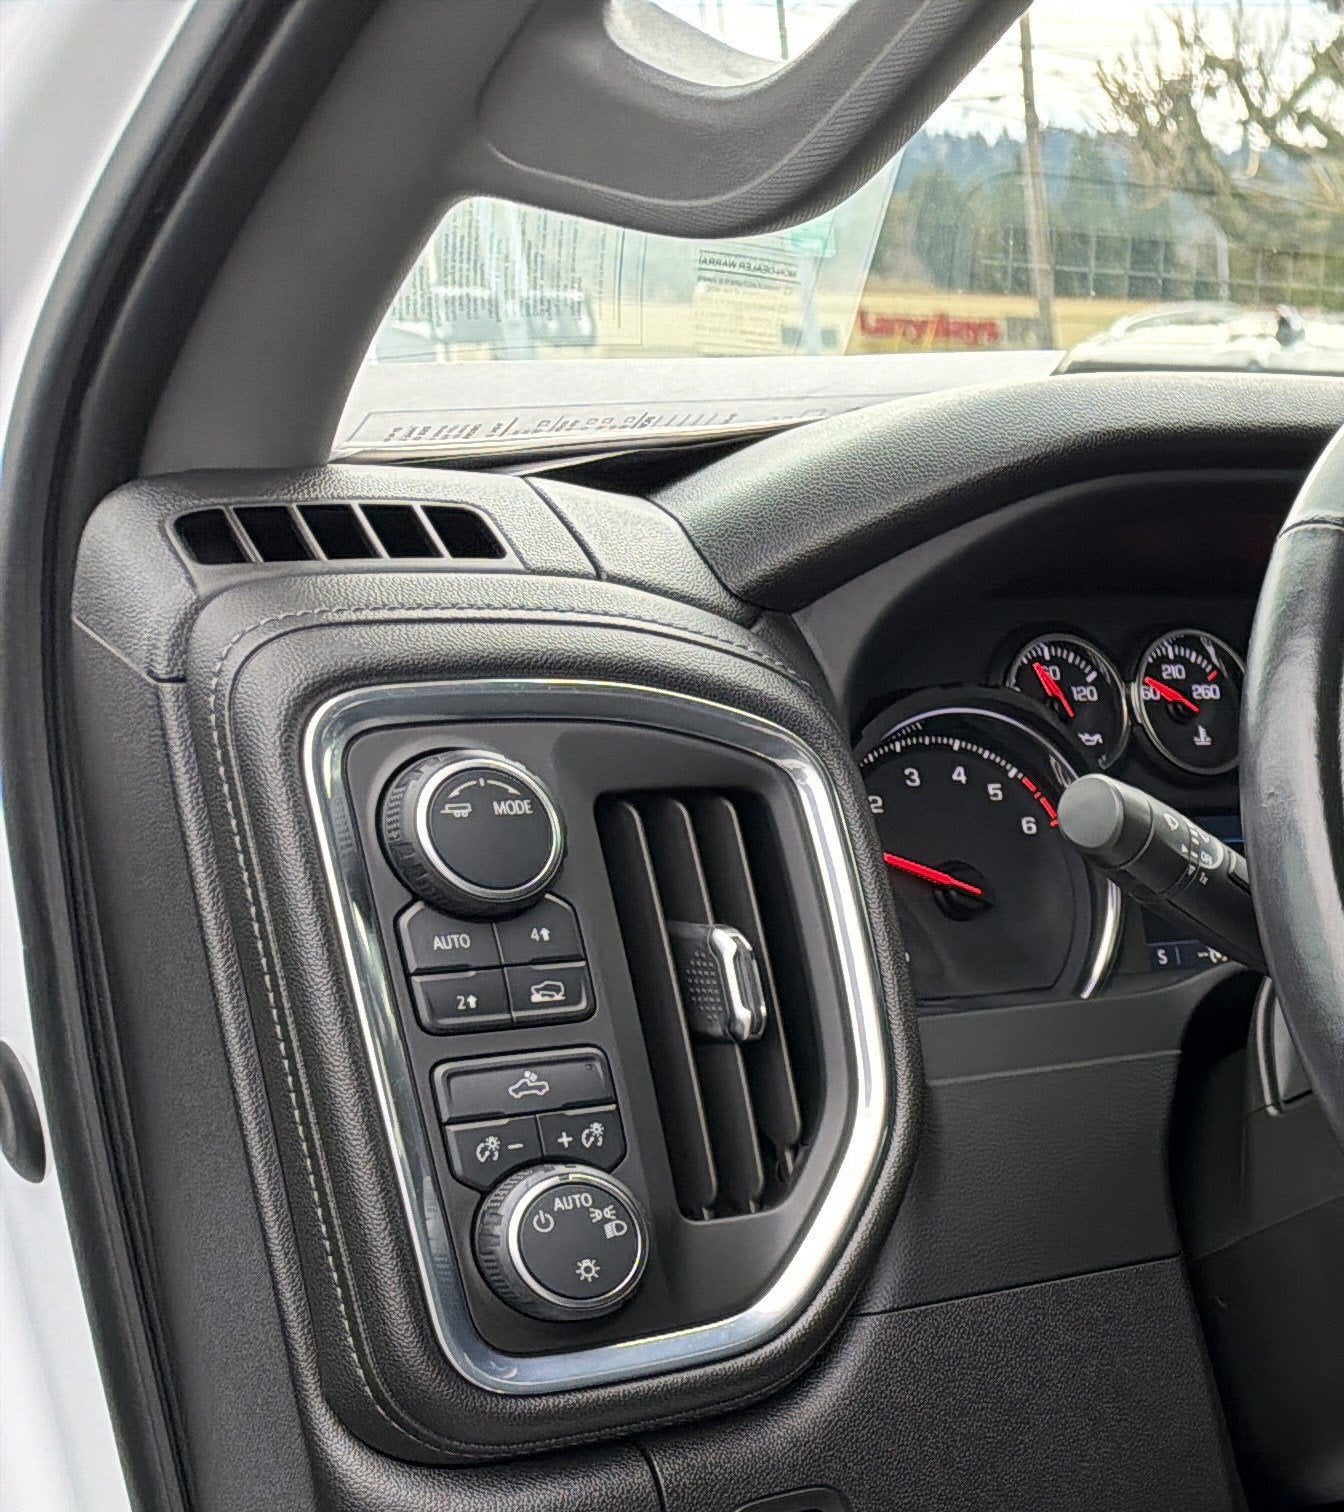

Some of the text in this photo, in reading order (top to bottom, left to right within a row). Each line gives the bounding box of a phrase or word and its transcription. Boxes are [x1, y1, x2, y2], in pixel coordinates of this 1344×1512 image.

[1161, 664, 1186, 680] 210
[1072, 685, 1099, 701] 120
[1191, 684, 1221, 700] 260
[903, 767, 921, 787] 3
[951, 766, 967, 785] 4
[986, 783, 1004, 801] 5
[492, 799, 534, 816] MODE
[868, 795, 884, 814] 2
[1021, 816, 1038, 835] 6
[433, 933, 471, 951] AUTO
[530, 927, 540, 942] 4
[1156, 949, 1168, 965] S
[456, 995, 467, 1010] 2
[553, 1192, 593, 1212] AUTO
